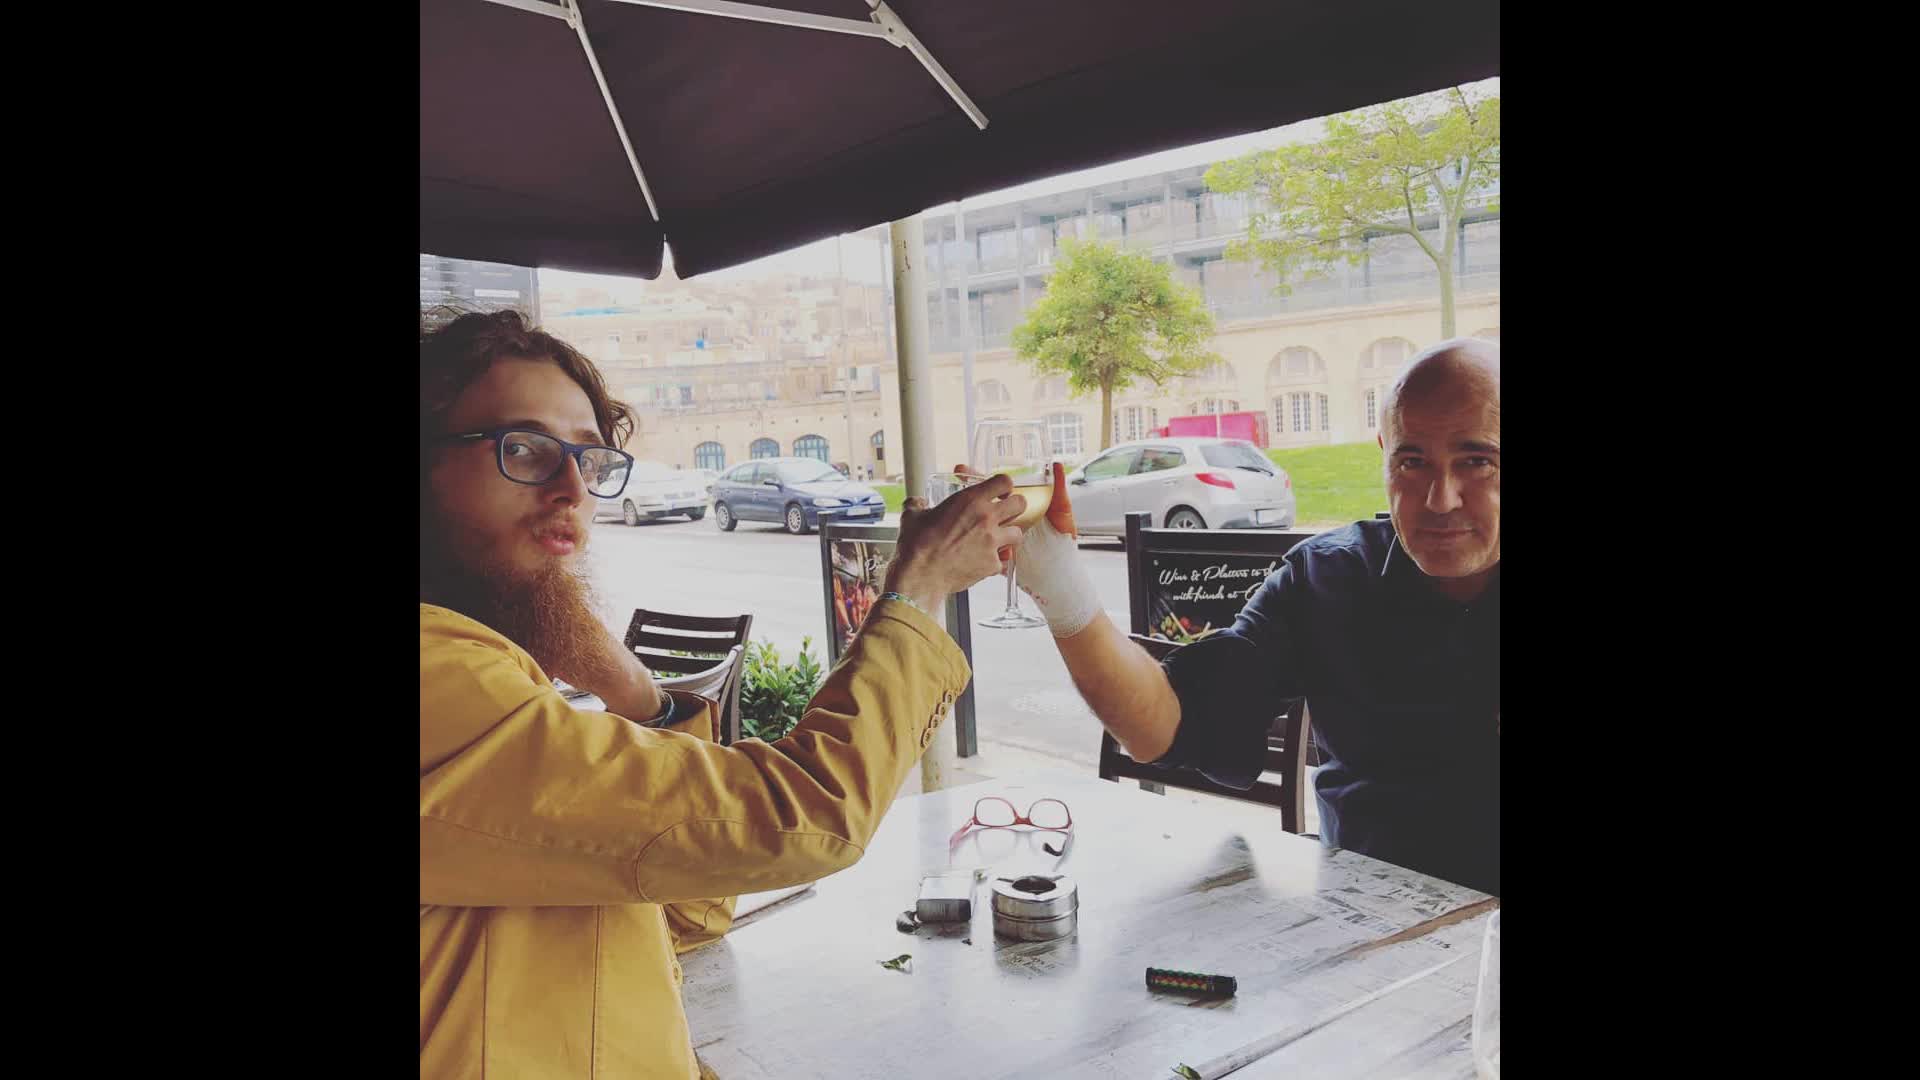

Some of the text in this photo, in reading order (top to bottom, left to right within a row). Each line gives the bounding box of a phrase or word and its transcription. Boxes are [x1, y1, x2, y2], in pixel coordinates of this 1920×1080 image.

[1159, 568, 1188, 585] Wine
[1190, 569, 1201, 582] &
[1202, 563, 1250, 582] Platters
[1173, 586, 1194, 601] with
[1193, 584, 1225, 603] friends
[1227, 591, 1239, 599] at
